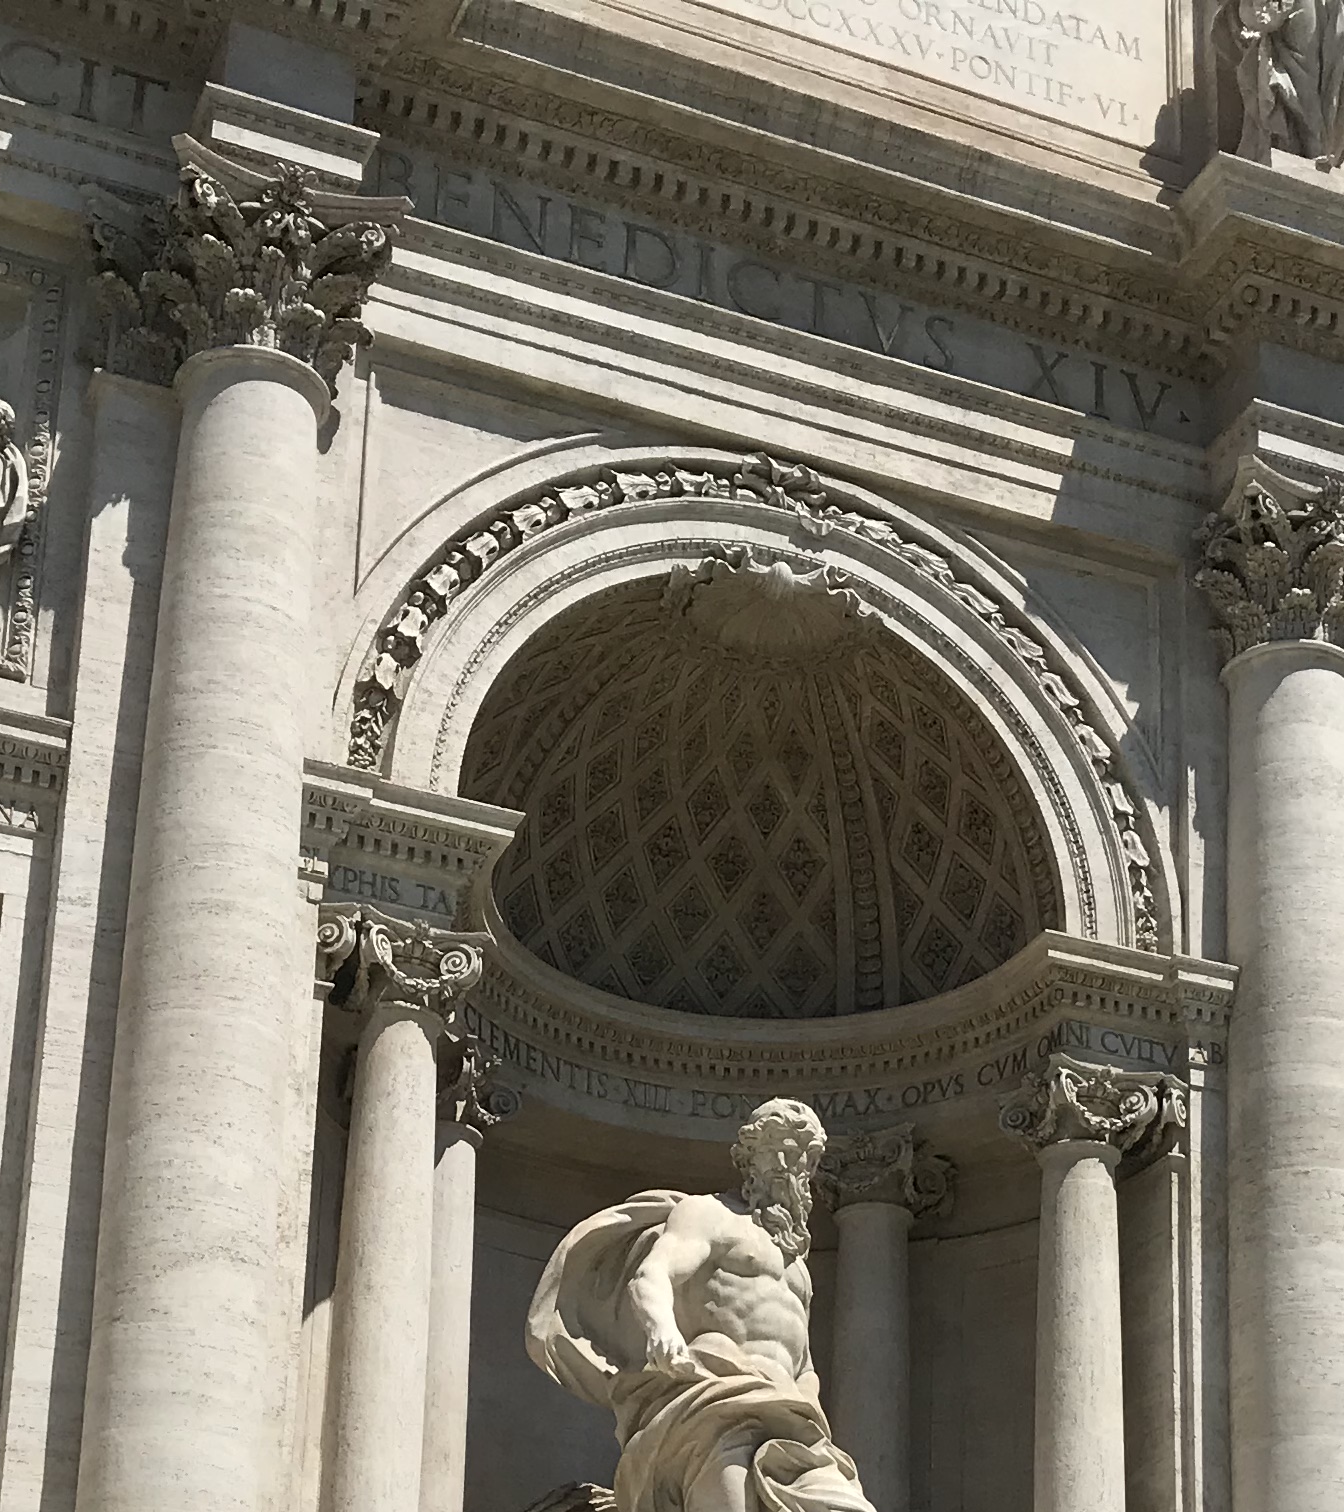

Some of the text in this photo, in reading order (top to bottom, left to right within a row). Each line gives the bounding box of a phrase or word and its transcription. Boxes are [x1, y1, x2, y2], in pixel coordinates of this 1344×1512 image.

[899, 0, 1058, 67] ORNAVIT
[375, 145, 955, 372] BENEDICTVS
[415, 882, 455, 916] TA
[900, 1072, 965, 1108] OPVS
[976, 1045, 1030, 1087] CVM
